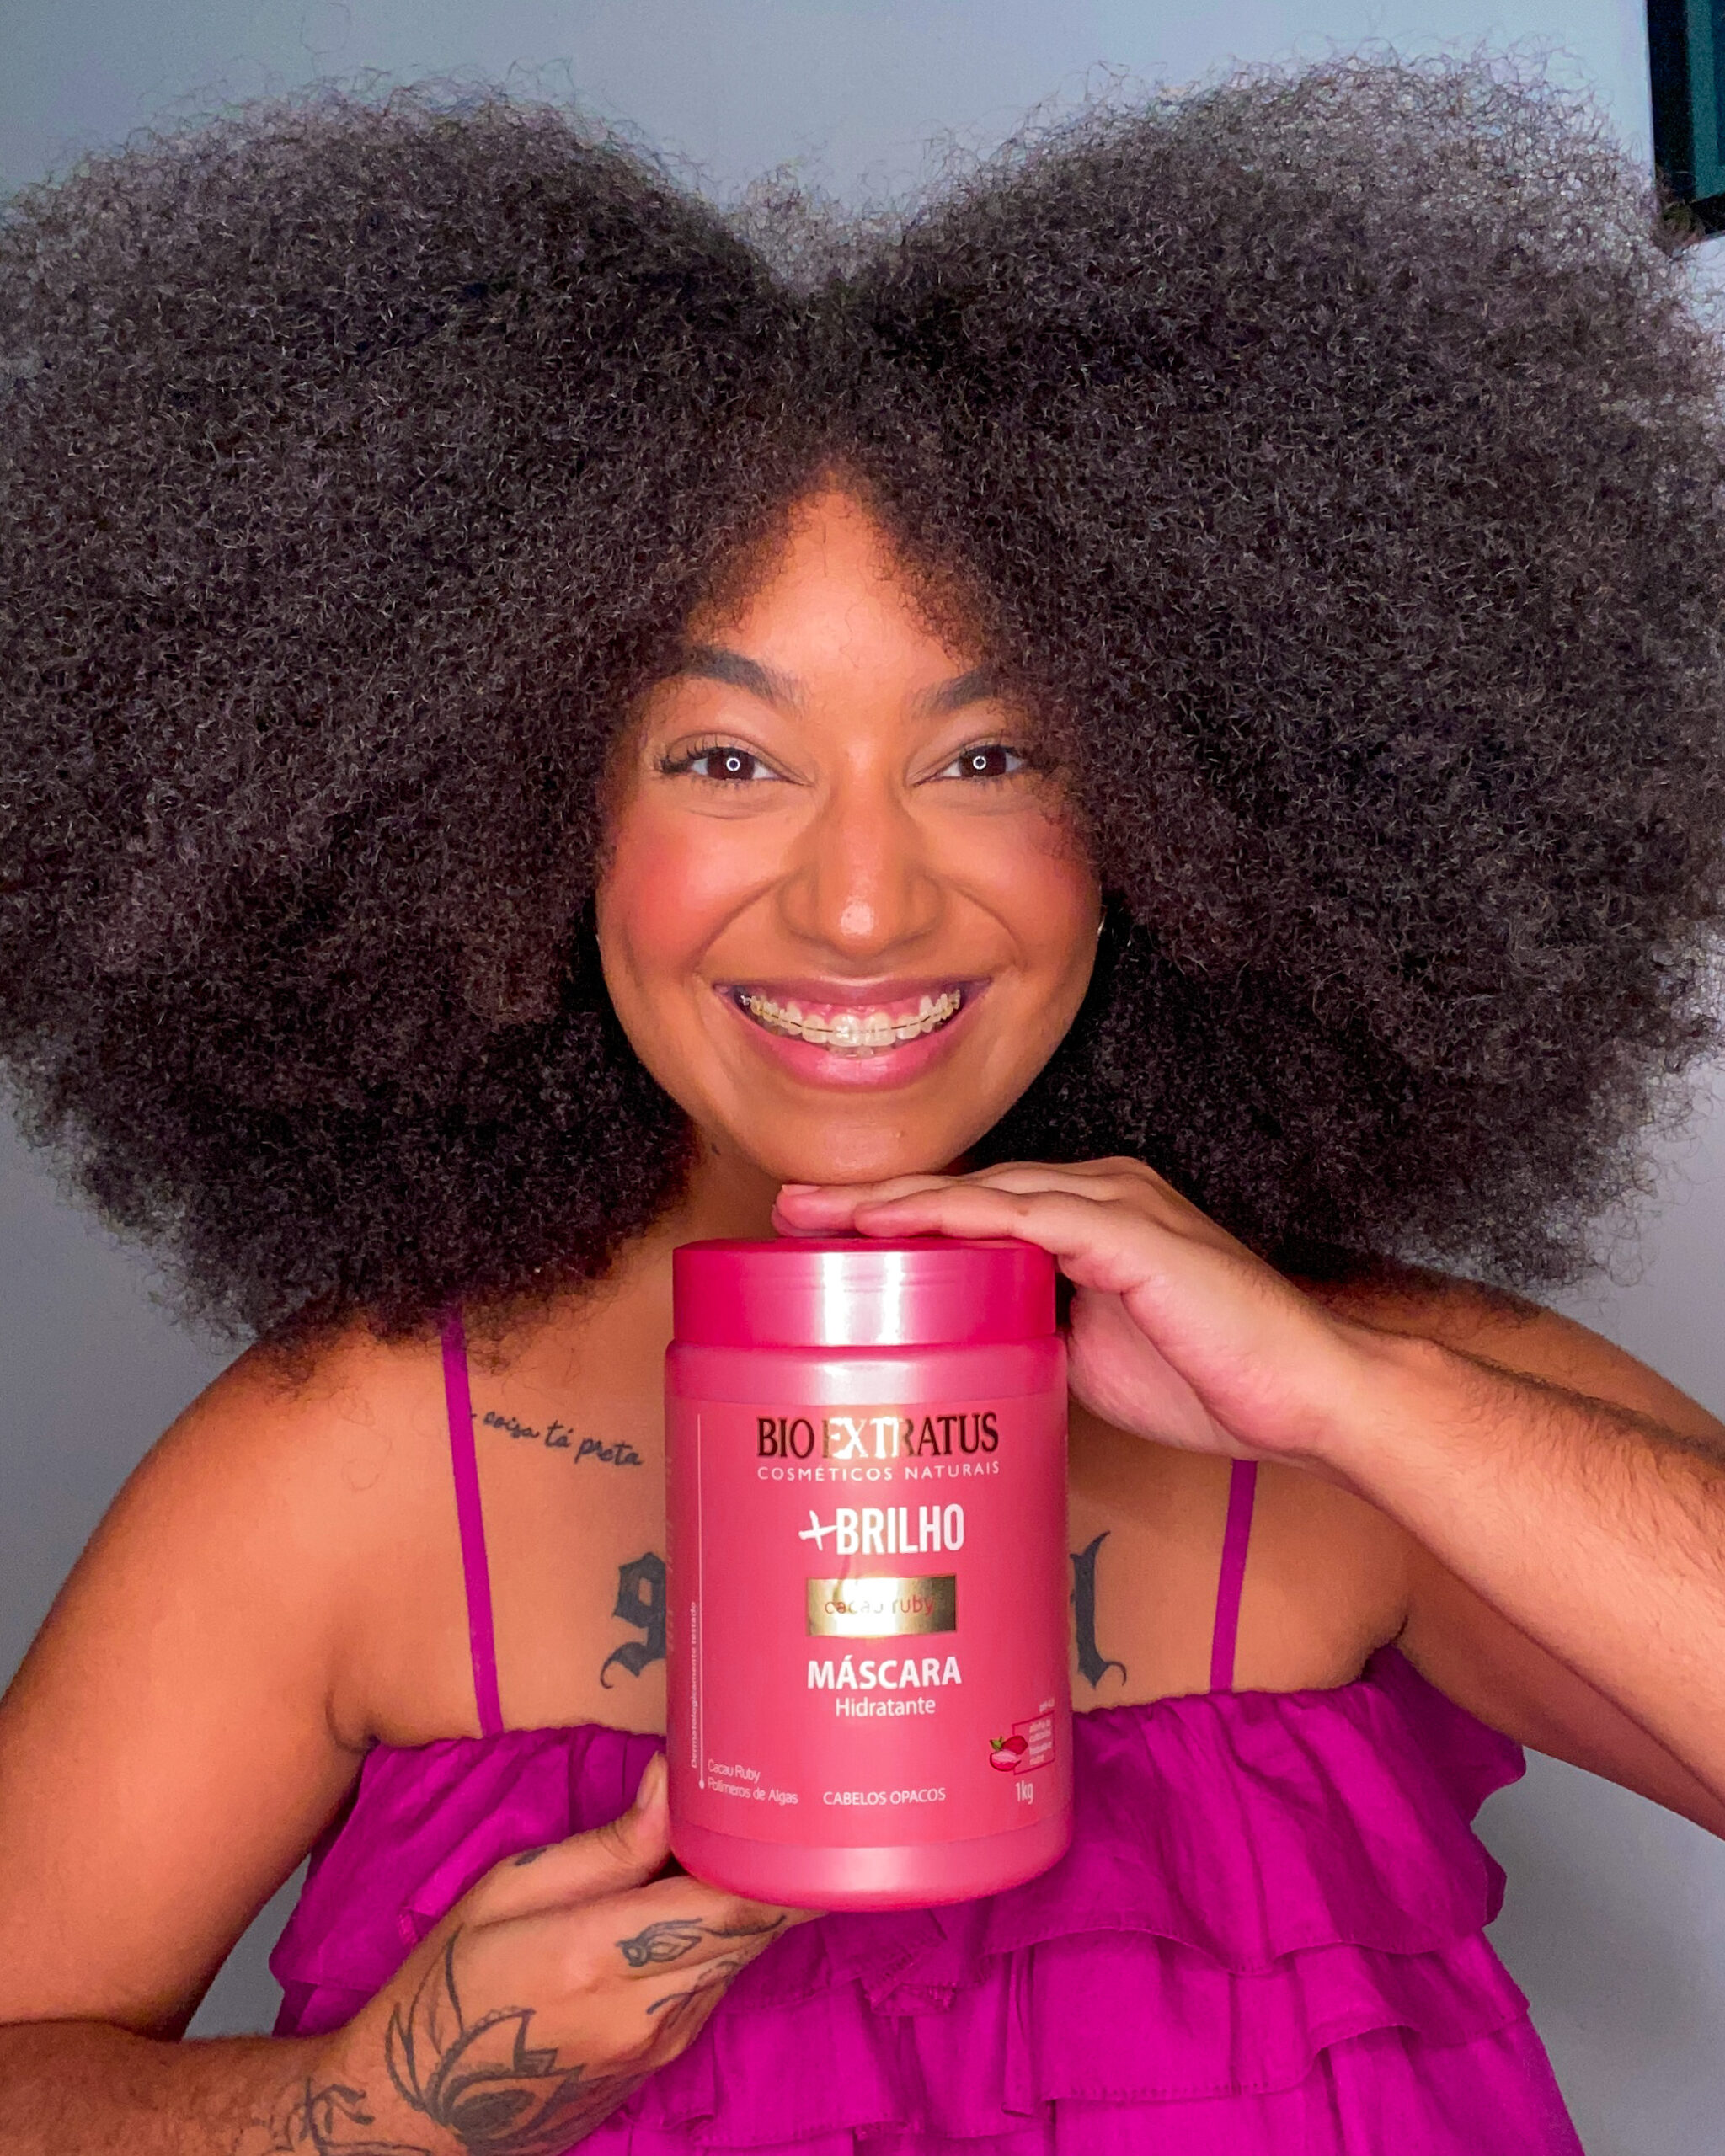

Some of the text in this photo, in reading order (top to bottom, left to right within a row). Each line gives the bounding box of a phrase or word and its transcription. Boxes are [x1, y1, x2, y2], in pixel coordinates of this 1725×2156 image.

[544, 1420, 574, 1448] tá
[574, 1437, 644, 1465] preta
[756, 1412, 1000, 1459] BIO EXTRATUS
[757, 1460, 1000, 1482] COSMÉTICOS NATURAIS
[891, 1594, 934, 1616] ruby
[807, 1655, 962, 1689] MÁSCARA
[836, 1696, 937, 1717] Hidratante
[708, 1758, 761, 1784] Cacau Ruby
[753, 1787, 766, 1801] de
[767, 1789, 798, 1806] Algas
[823, 1787, 946, 1806] CABELOS OPACOS
[1016, 1780, 1033, 1805] 1kg
